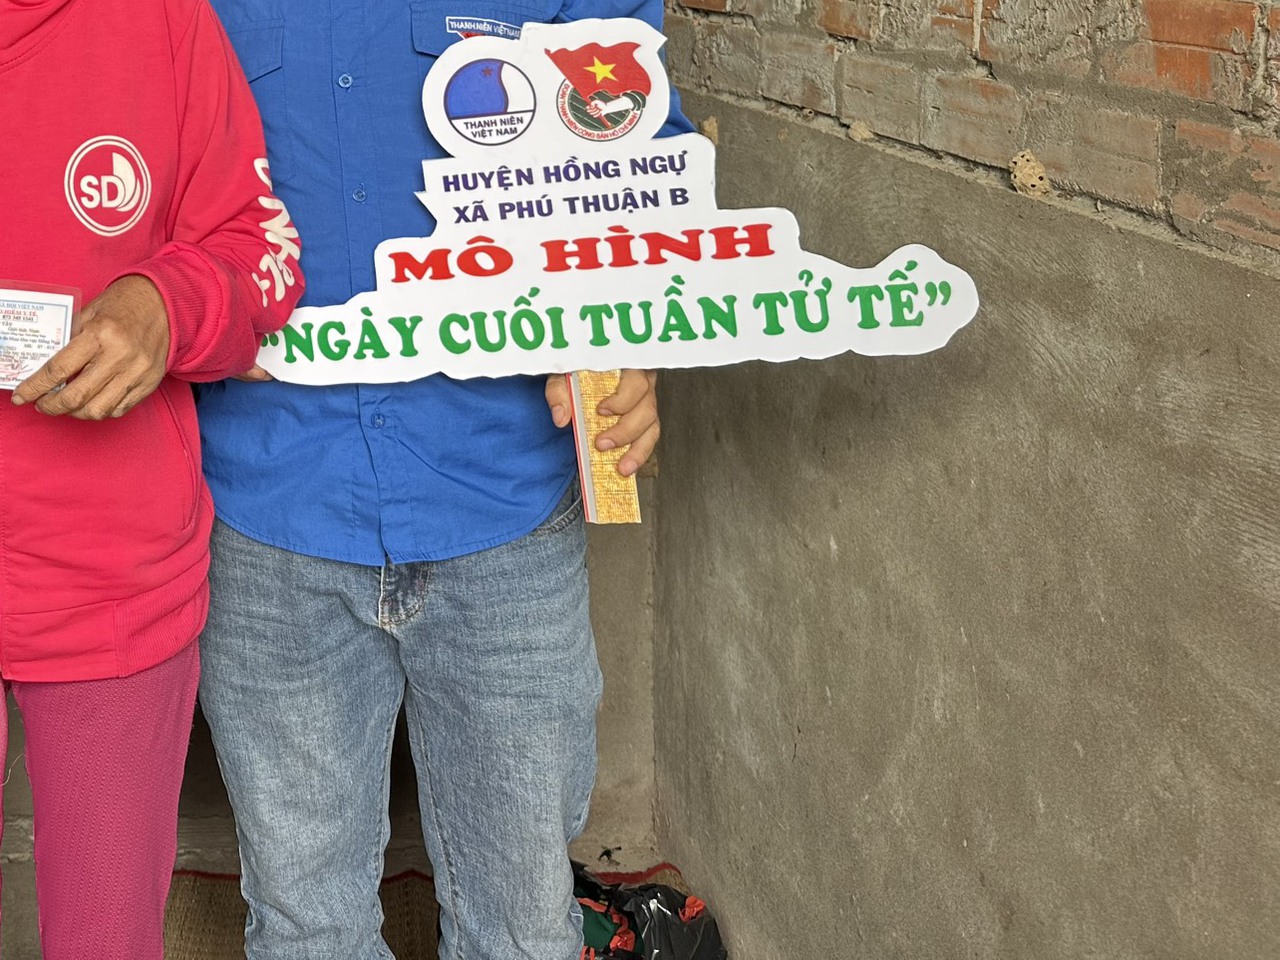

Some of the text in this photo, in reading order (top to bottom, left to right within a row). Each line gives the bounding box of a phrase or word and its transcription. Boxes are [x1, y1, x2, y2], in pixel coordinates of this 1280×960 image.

[449, 21, 475, 29] THANH
[463, 115, 524, 130] THANH NIÊN
[470, 126, 518, 139] VIỆT NAM
[442, 149, 688, 193] HUYỆN HỒNG NGỰ
[79, 175, 126, 209] SD
[453, 188, 690, 224] XÃ PHÚ THUẬN B
[390, 223, 775, 284] MÔ HÌNH
[439, 287, 569, 356] CUỐI
[580, 274, 738, 347] TUẦN
[752, 269, 833, 337] TỬ
